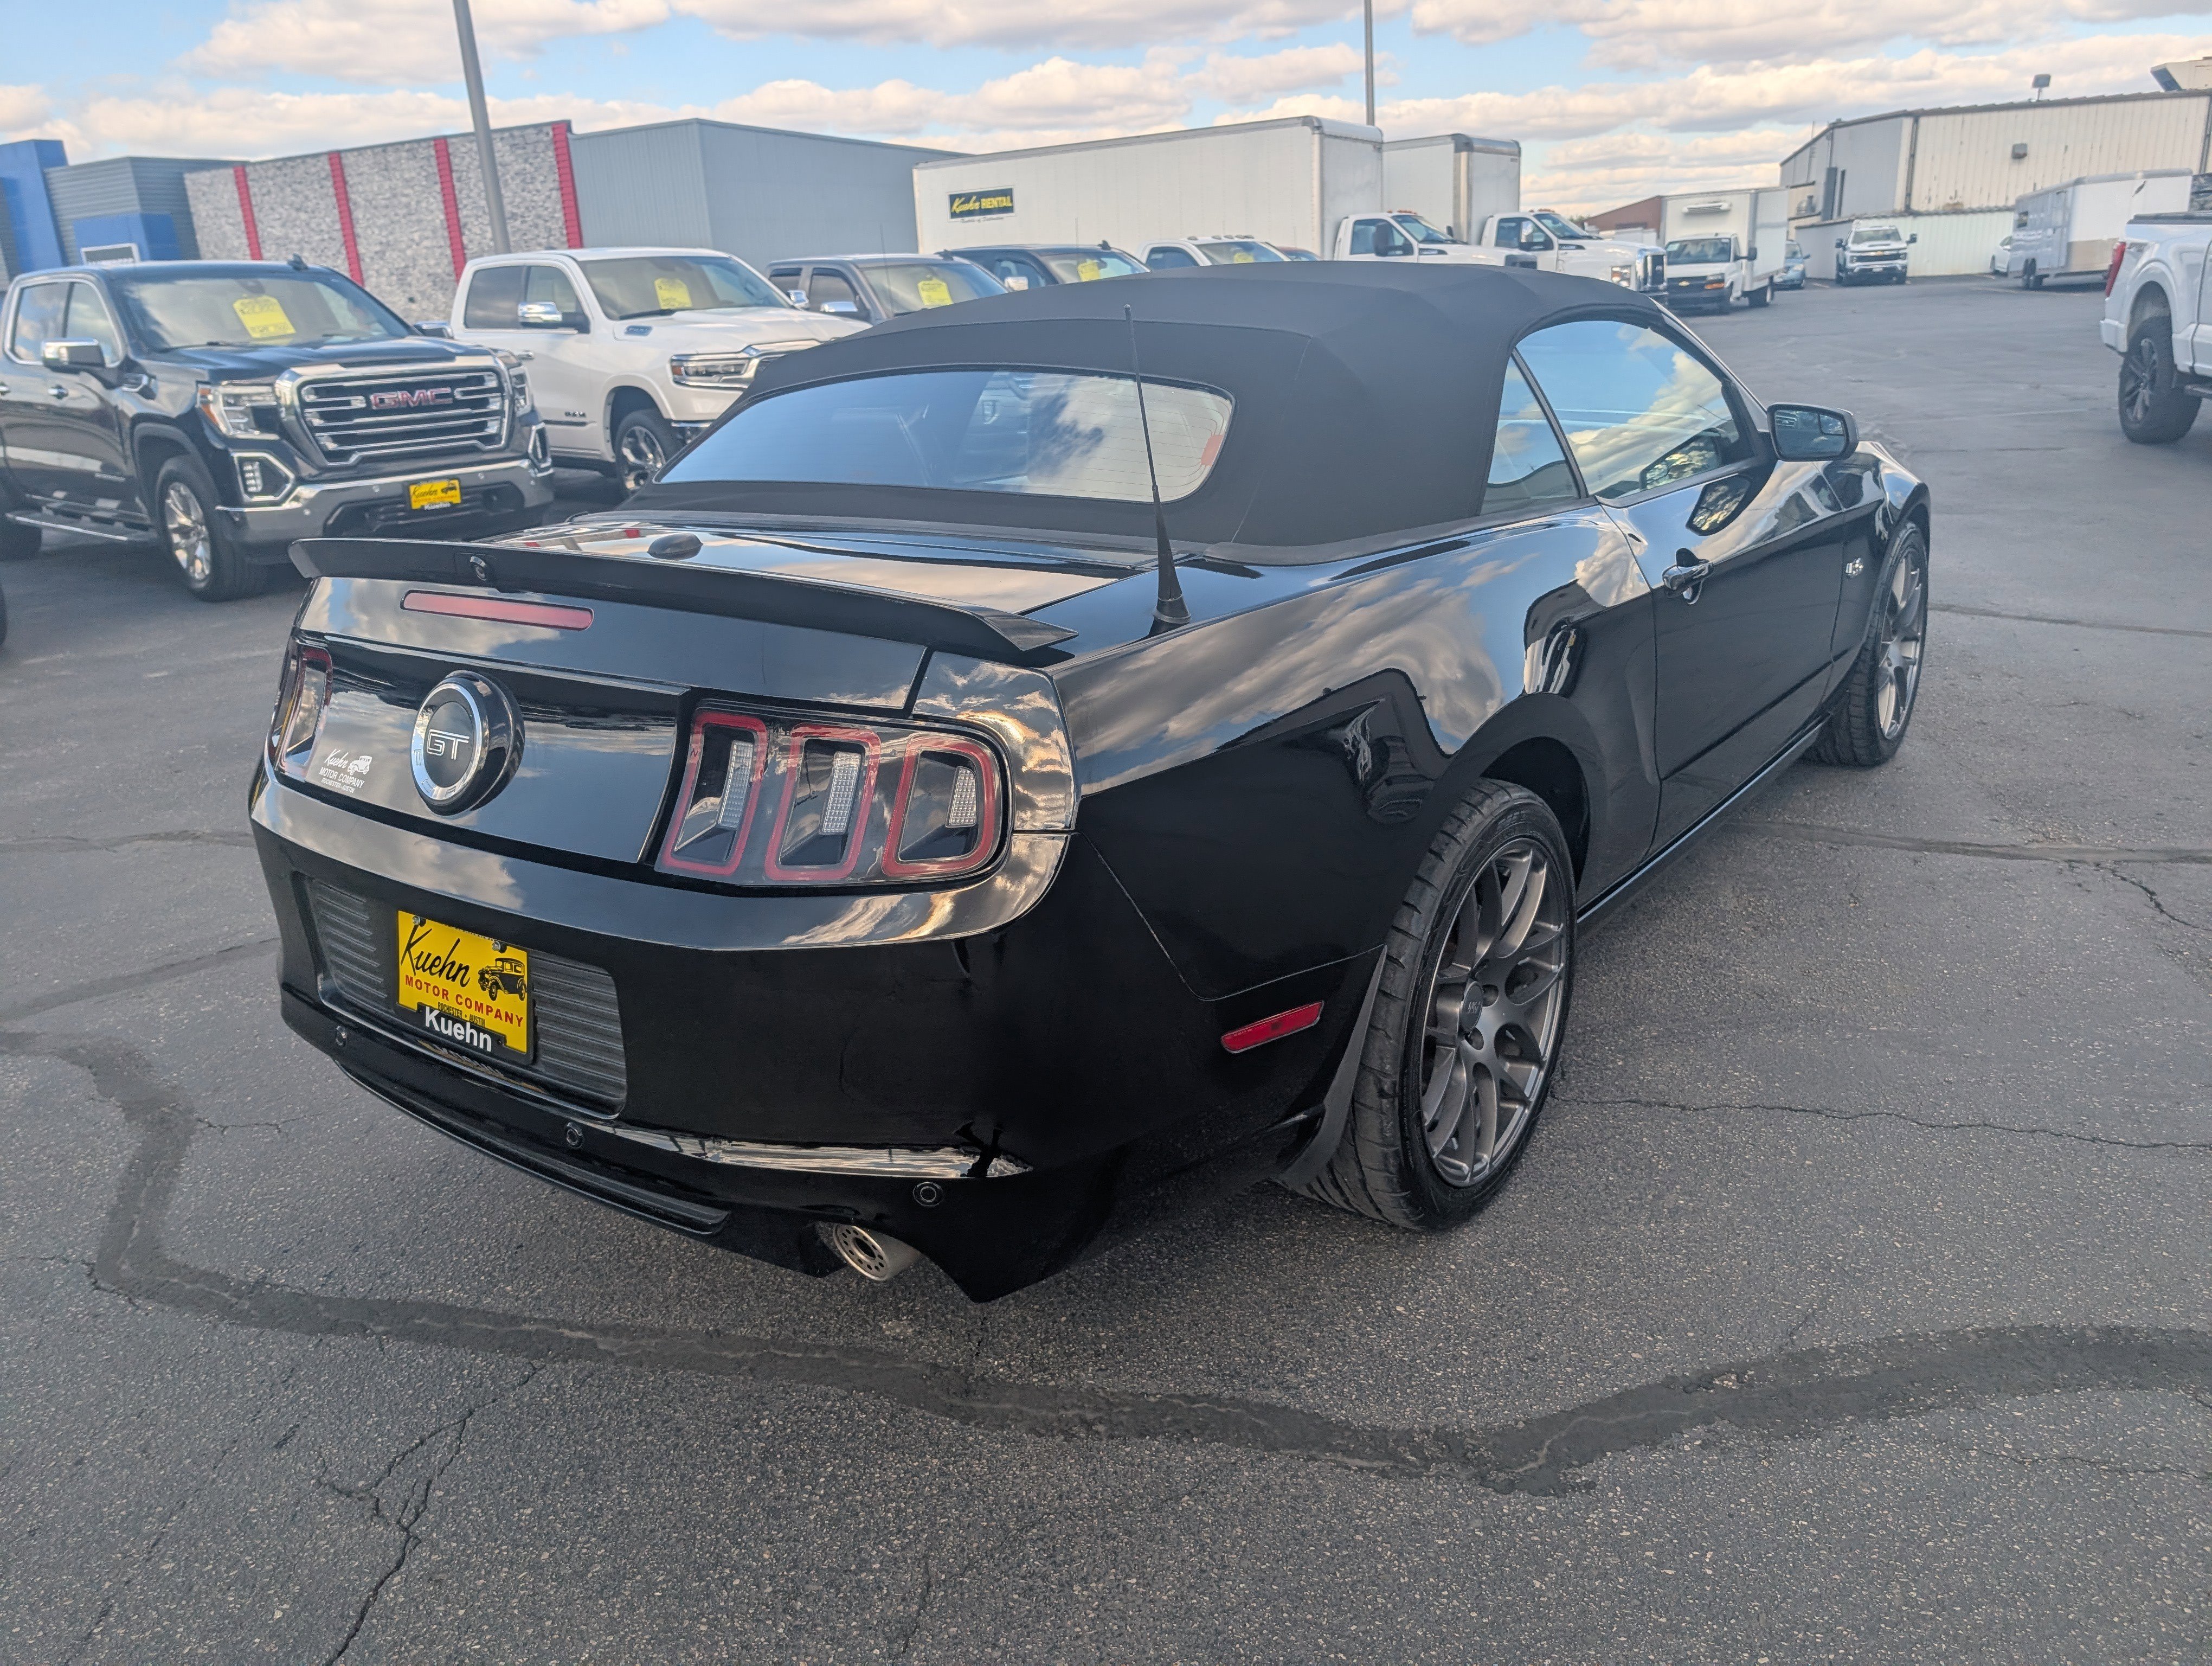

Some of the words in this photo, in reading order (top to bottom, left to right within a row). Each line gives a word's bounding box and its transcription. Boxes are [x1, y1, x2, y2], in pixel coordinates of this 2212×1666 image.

[980, 196, 1012, 209] RENTAL
[370, 387, 454, 409] GMC
[324, 748, 349, 768] Kuehn
[426, 729, 470, 760] GT
[319, 766, 338, 780] MOTOR
[338, 773, 365, 789] COMPANY
[400, 924, 471, 988] Kuehn
[405, 974, 449, 1001] MOTOR
[455, 994, 524, 1028] COMPANY
[438, 1001, 463, 1019] ROCHESTER
[469, 1014, 486, 1028] AUSTIN
[425, 1006, 492, 1052] Kuehn
